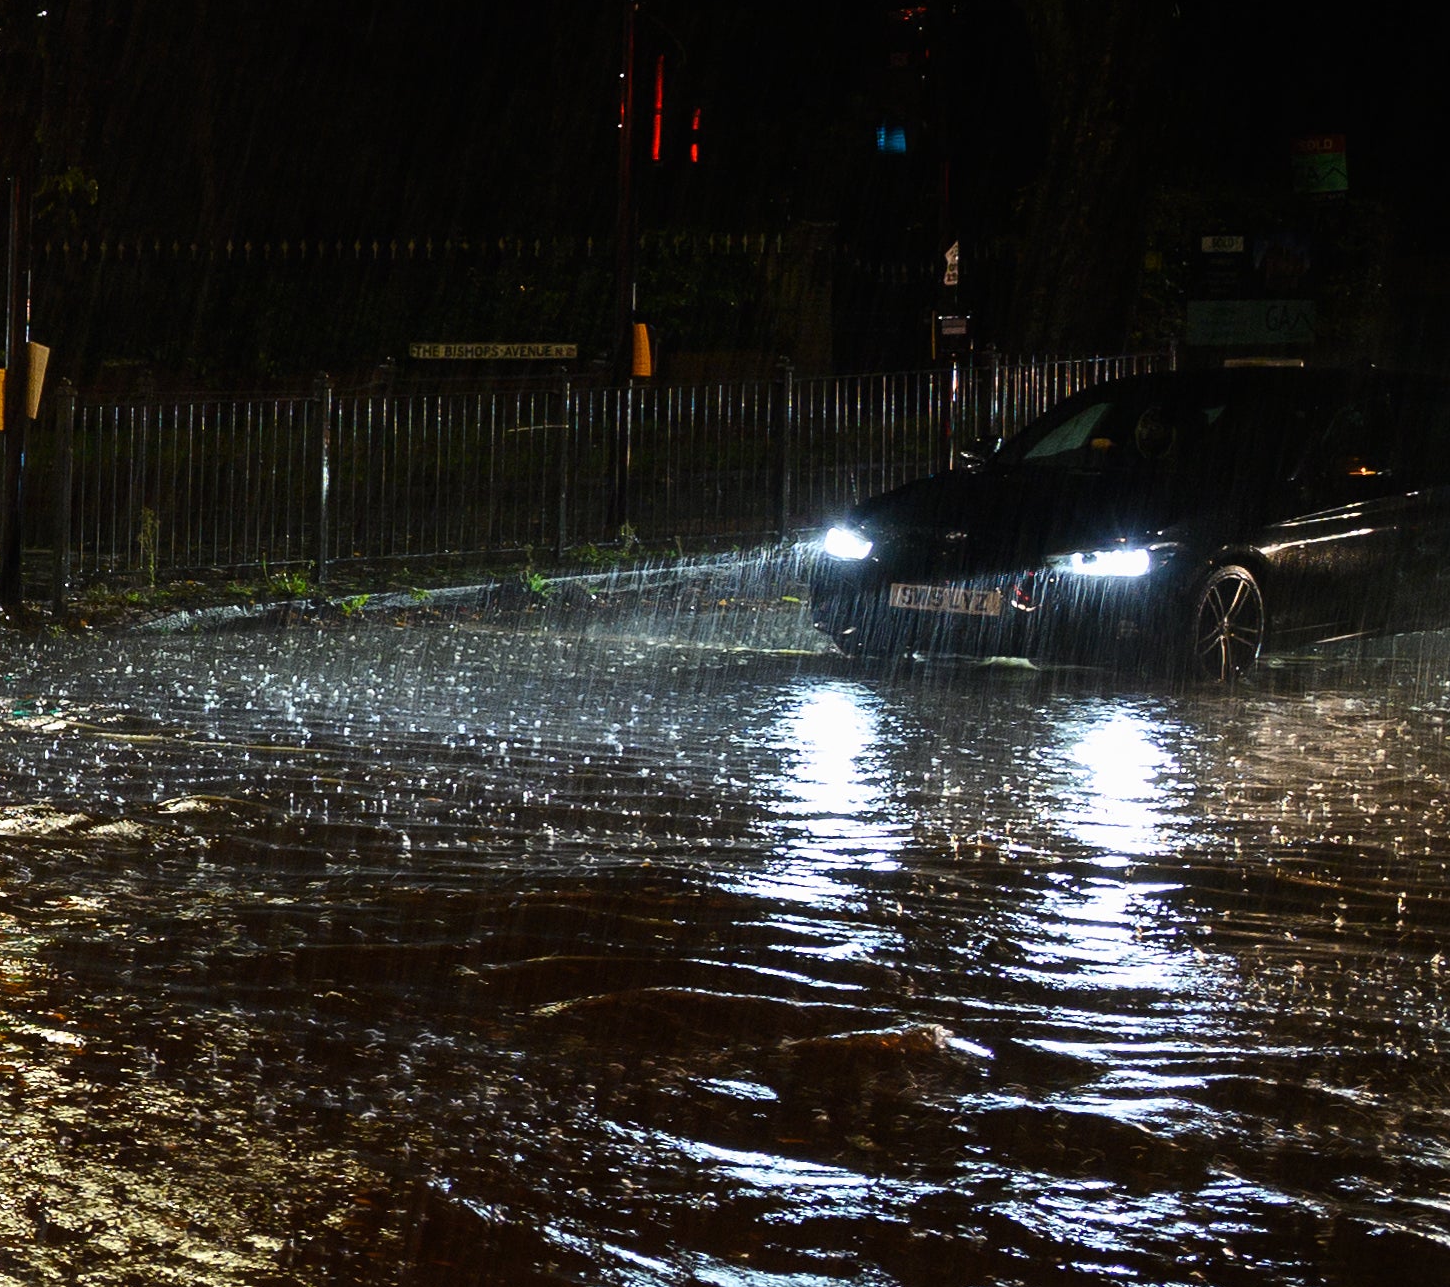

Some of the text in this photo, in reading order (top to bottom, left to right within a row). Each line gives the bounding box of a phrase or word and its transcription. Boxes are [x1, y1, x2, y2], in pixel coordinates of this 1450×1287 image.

[415, 345, 440, 357] THE
[444, 345, 500, 357] BISHOPS
[503, 345, 553, 357] AVENUE
